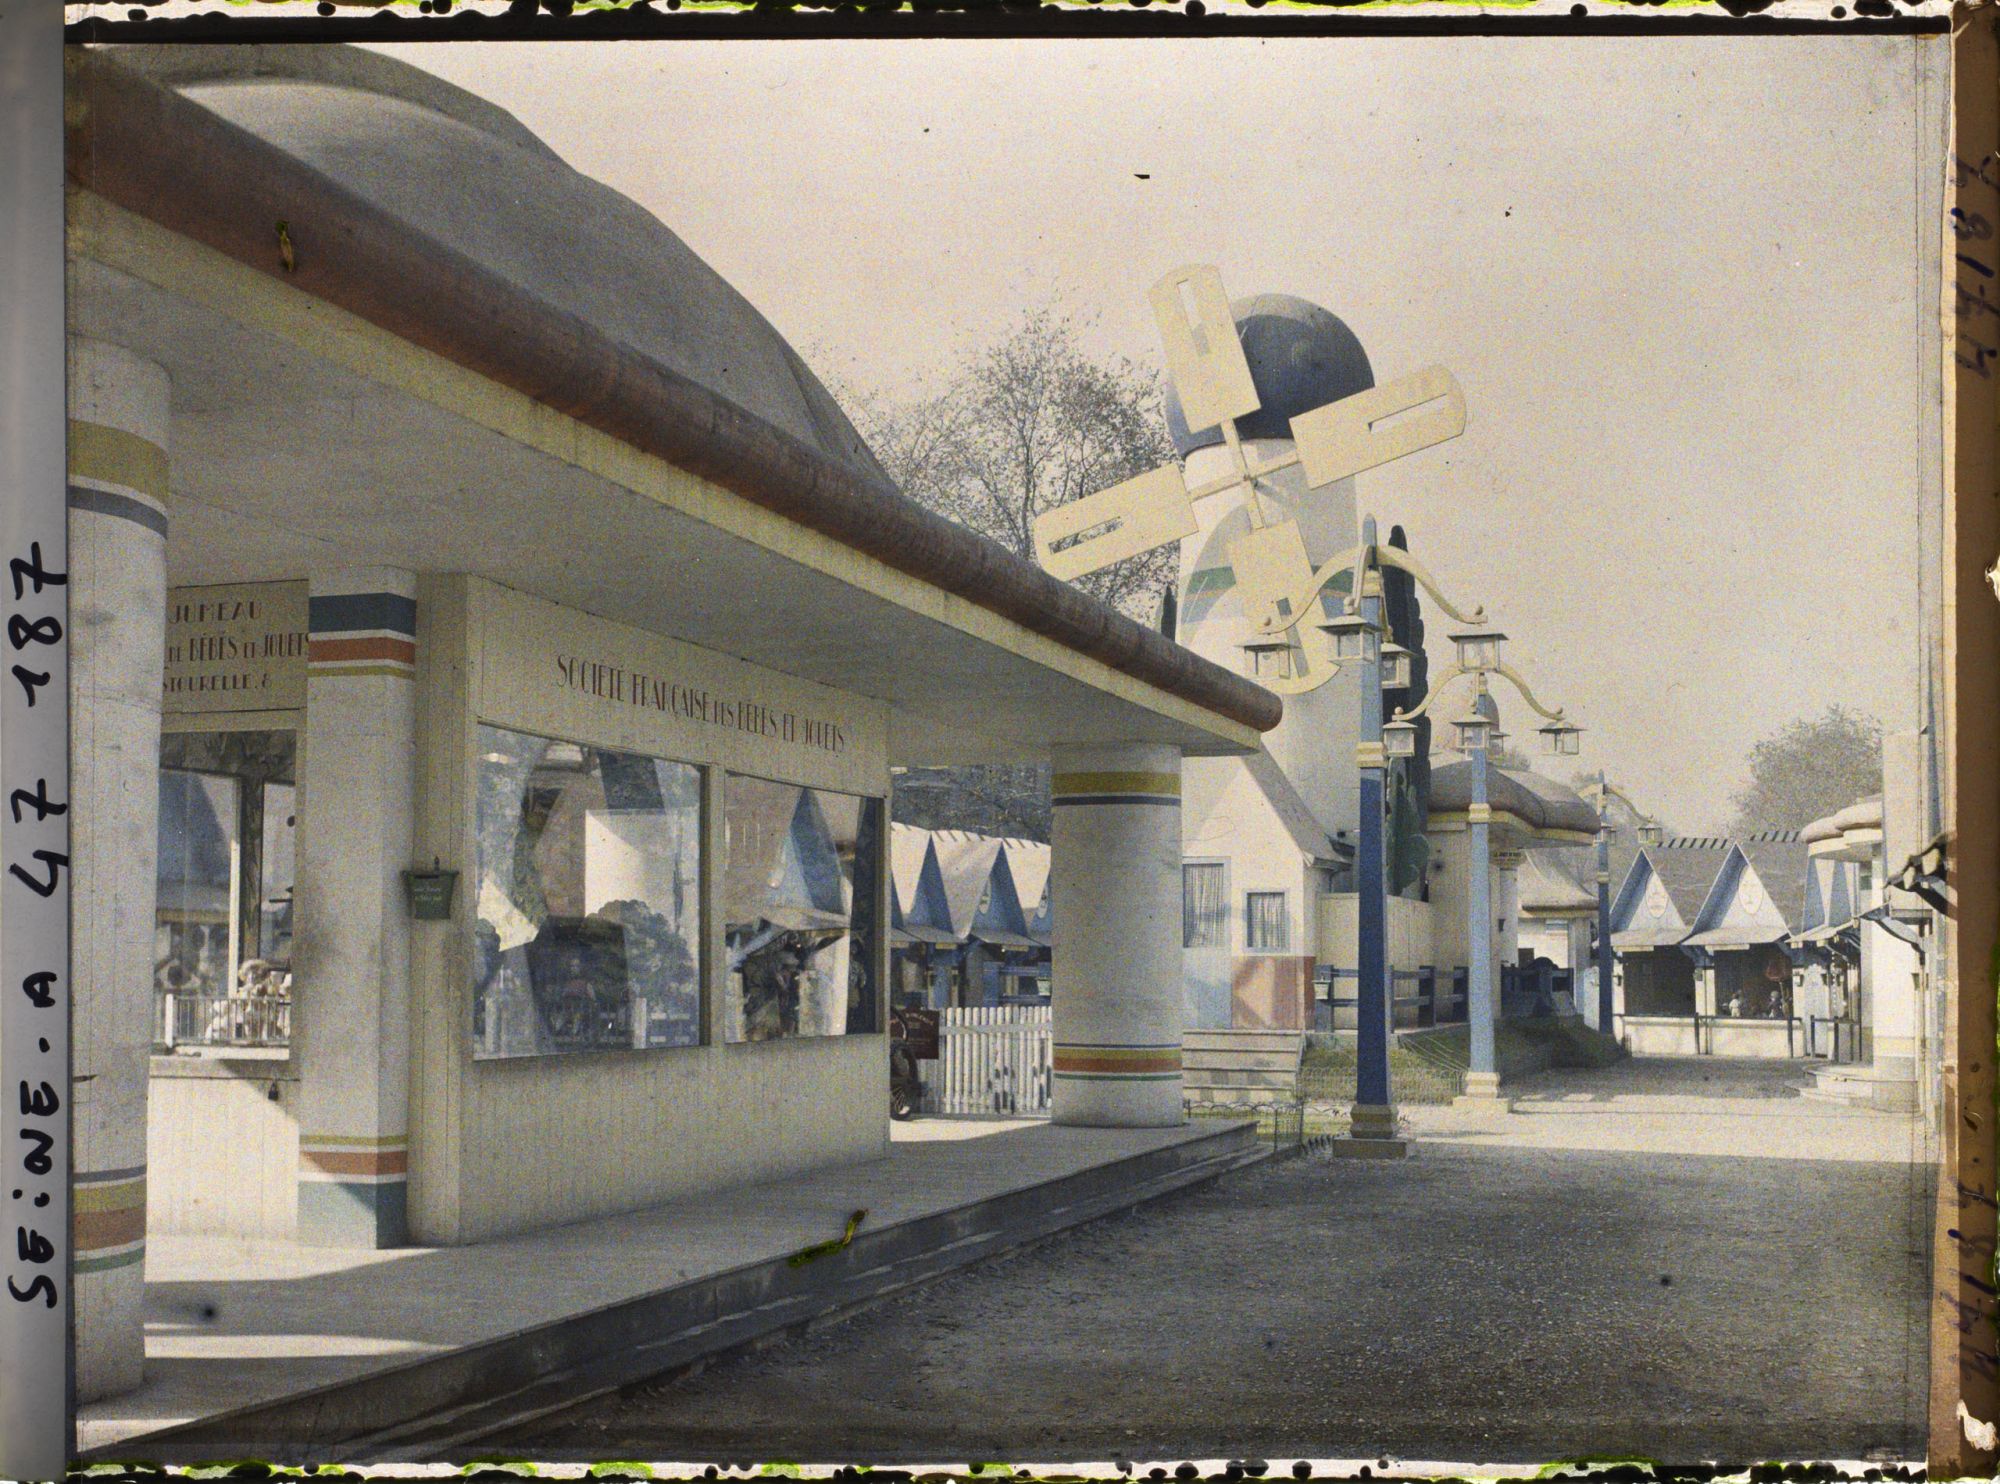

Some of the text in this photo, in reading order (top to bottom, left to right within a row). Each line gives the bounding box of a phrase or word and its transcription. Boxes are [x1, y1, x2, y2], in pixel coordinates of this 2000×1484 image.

[8, 540, 68, 707] 187
[168, 600, 262, 624] JUMEAU
[243, 641, 257, 658] ET
[782, 713, 796, 743] ET
[9, 777, 68, 898] 47
[22, 970, 58, 1008] A
